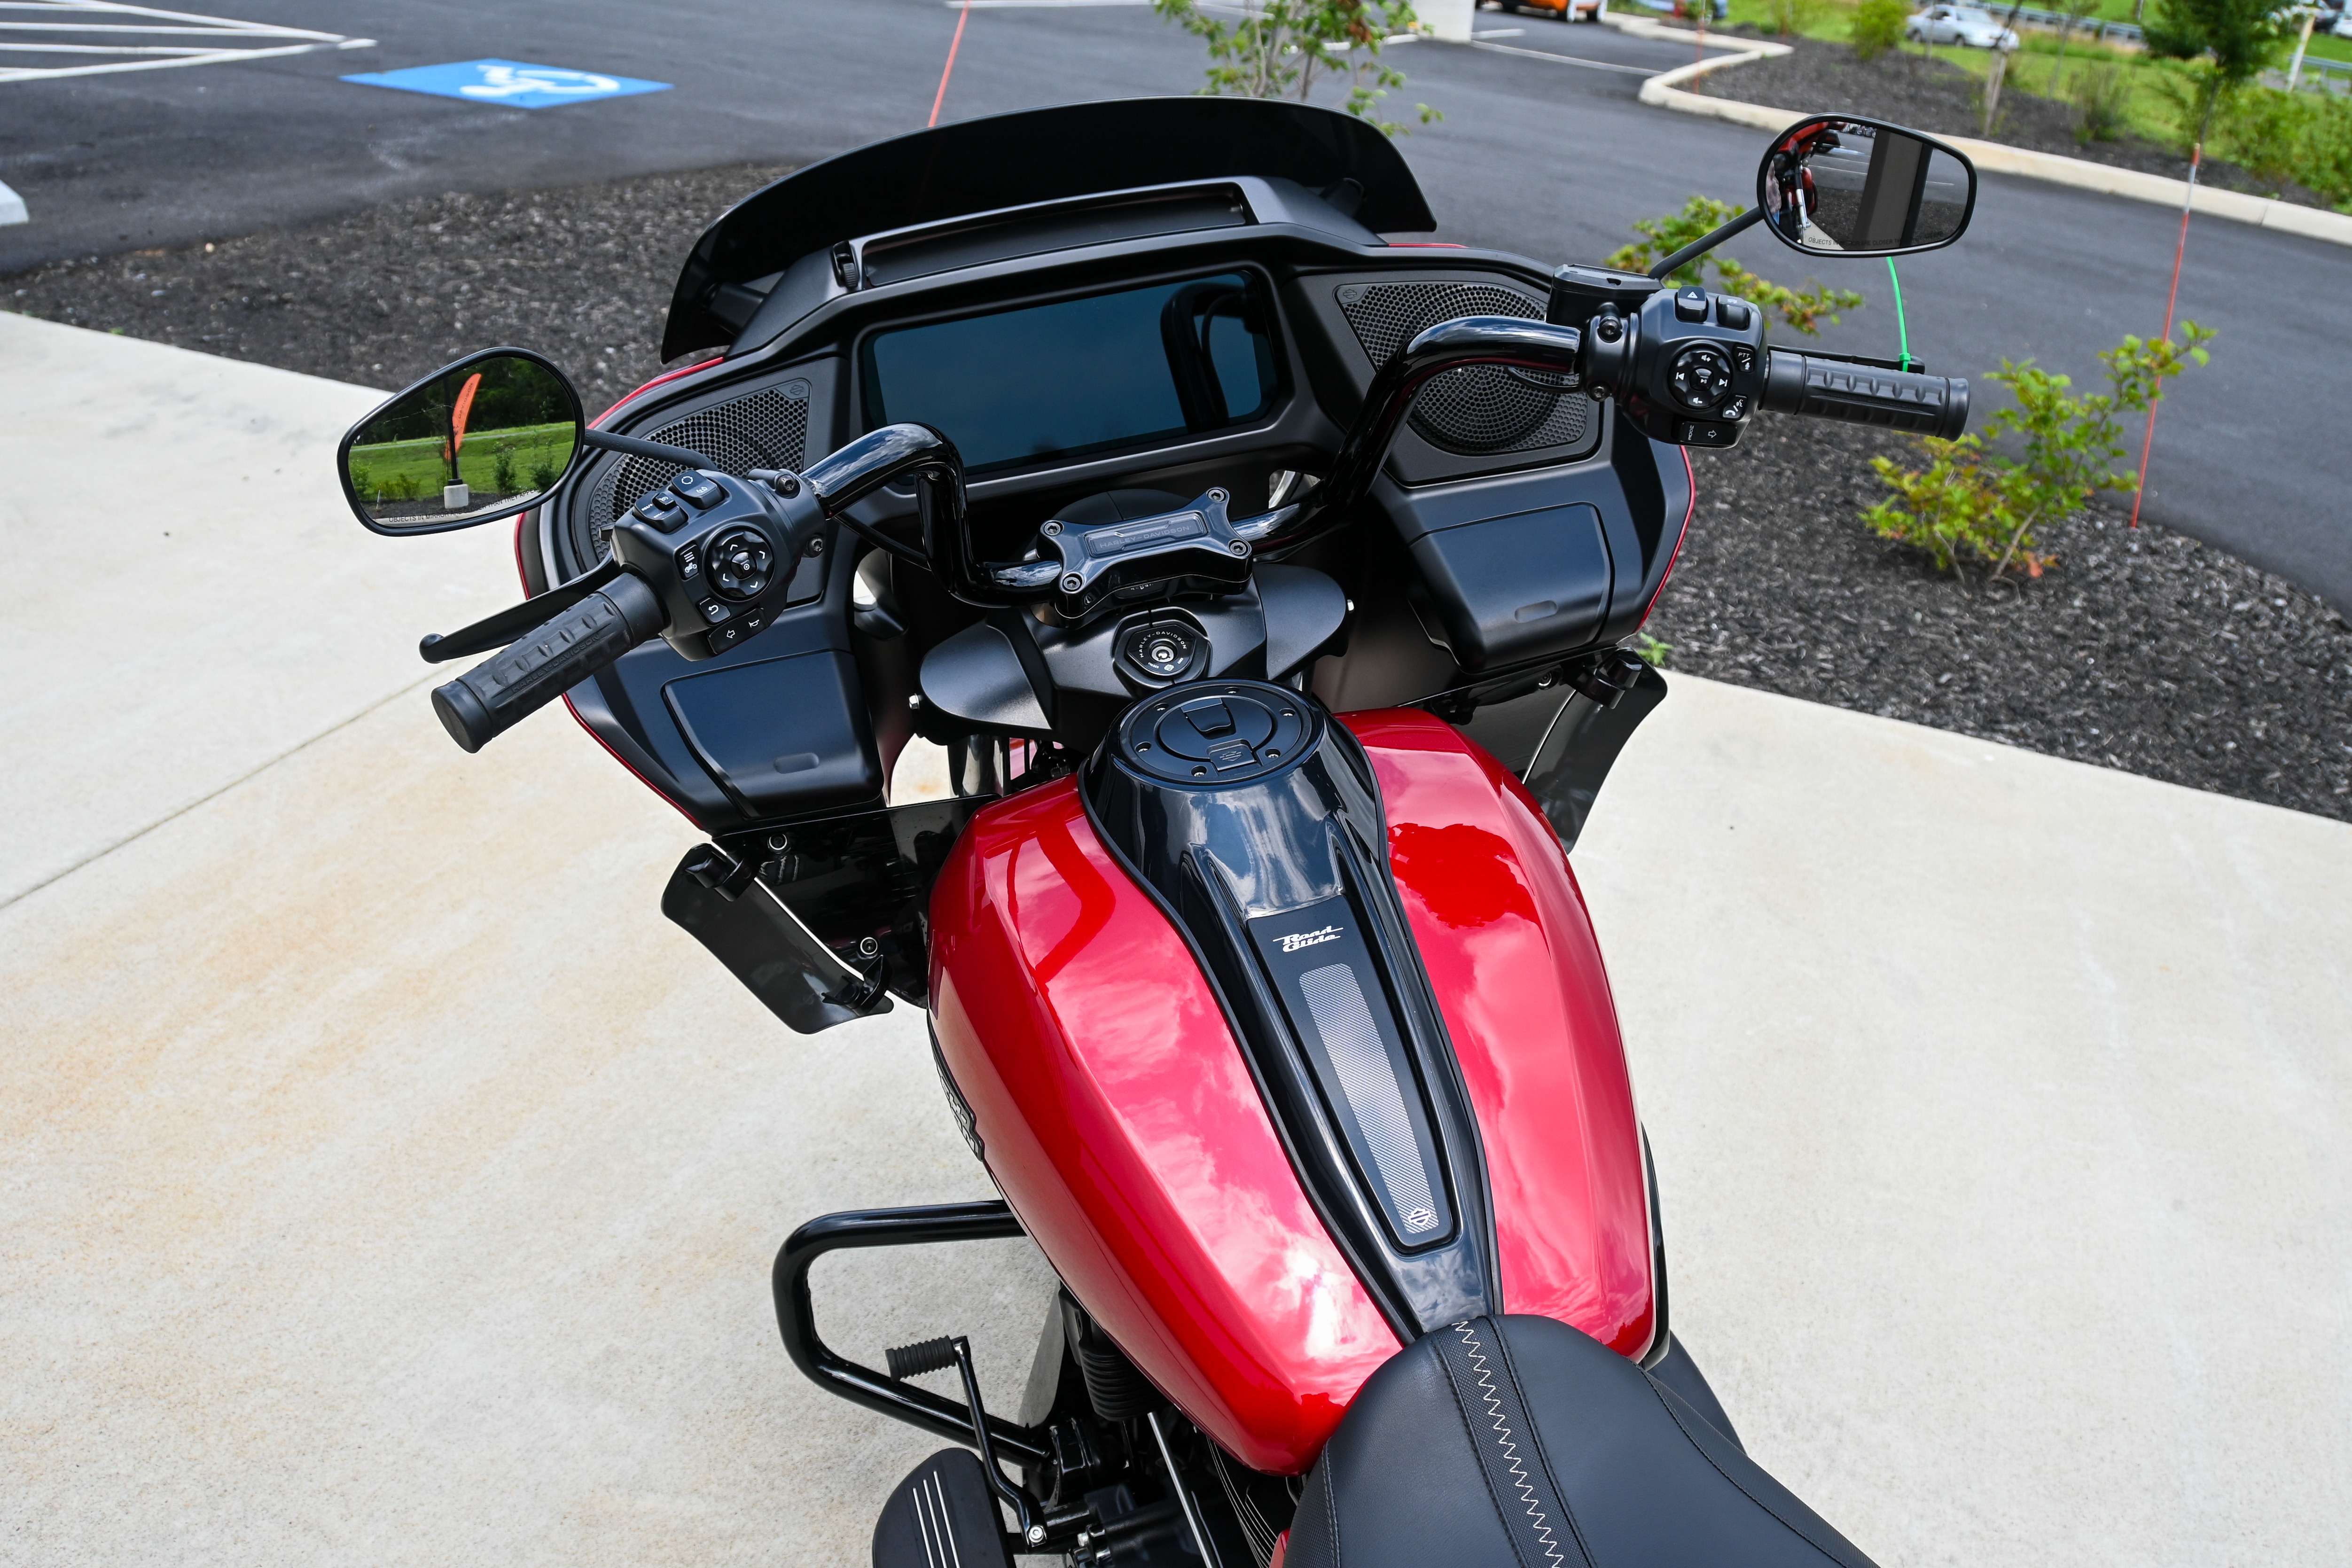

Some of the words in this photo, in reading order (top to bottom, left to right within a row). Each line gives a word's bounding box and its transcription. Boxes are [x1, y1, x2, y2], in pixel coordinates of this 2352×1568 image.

[458, 383, 473, 419] DAVIDSON
[425, 511, 449, 519] MIRROR
[463, 503, 486, 513] CLOSER
[1099, 526, 1190, 548] HARLEY-DAVIDSON
[1139, 631, 1187, 658] HARLEY-DAVIDSON
[511, 634, 599, 693] HARLEY-DAVIDSON
[1273, 925, 1344, 945] Road
[1282, 934, 1341, 952] Glide
